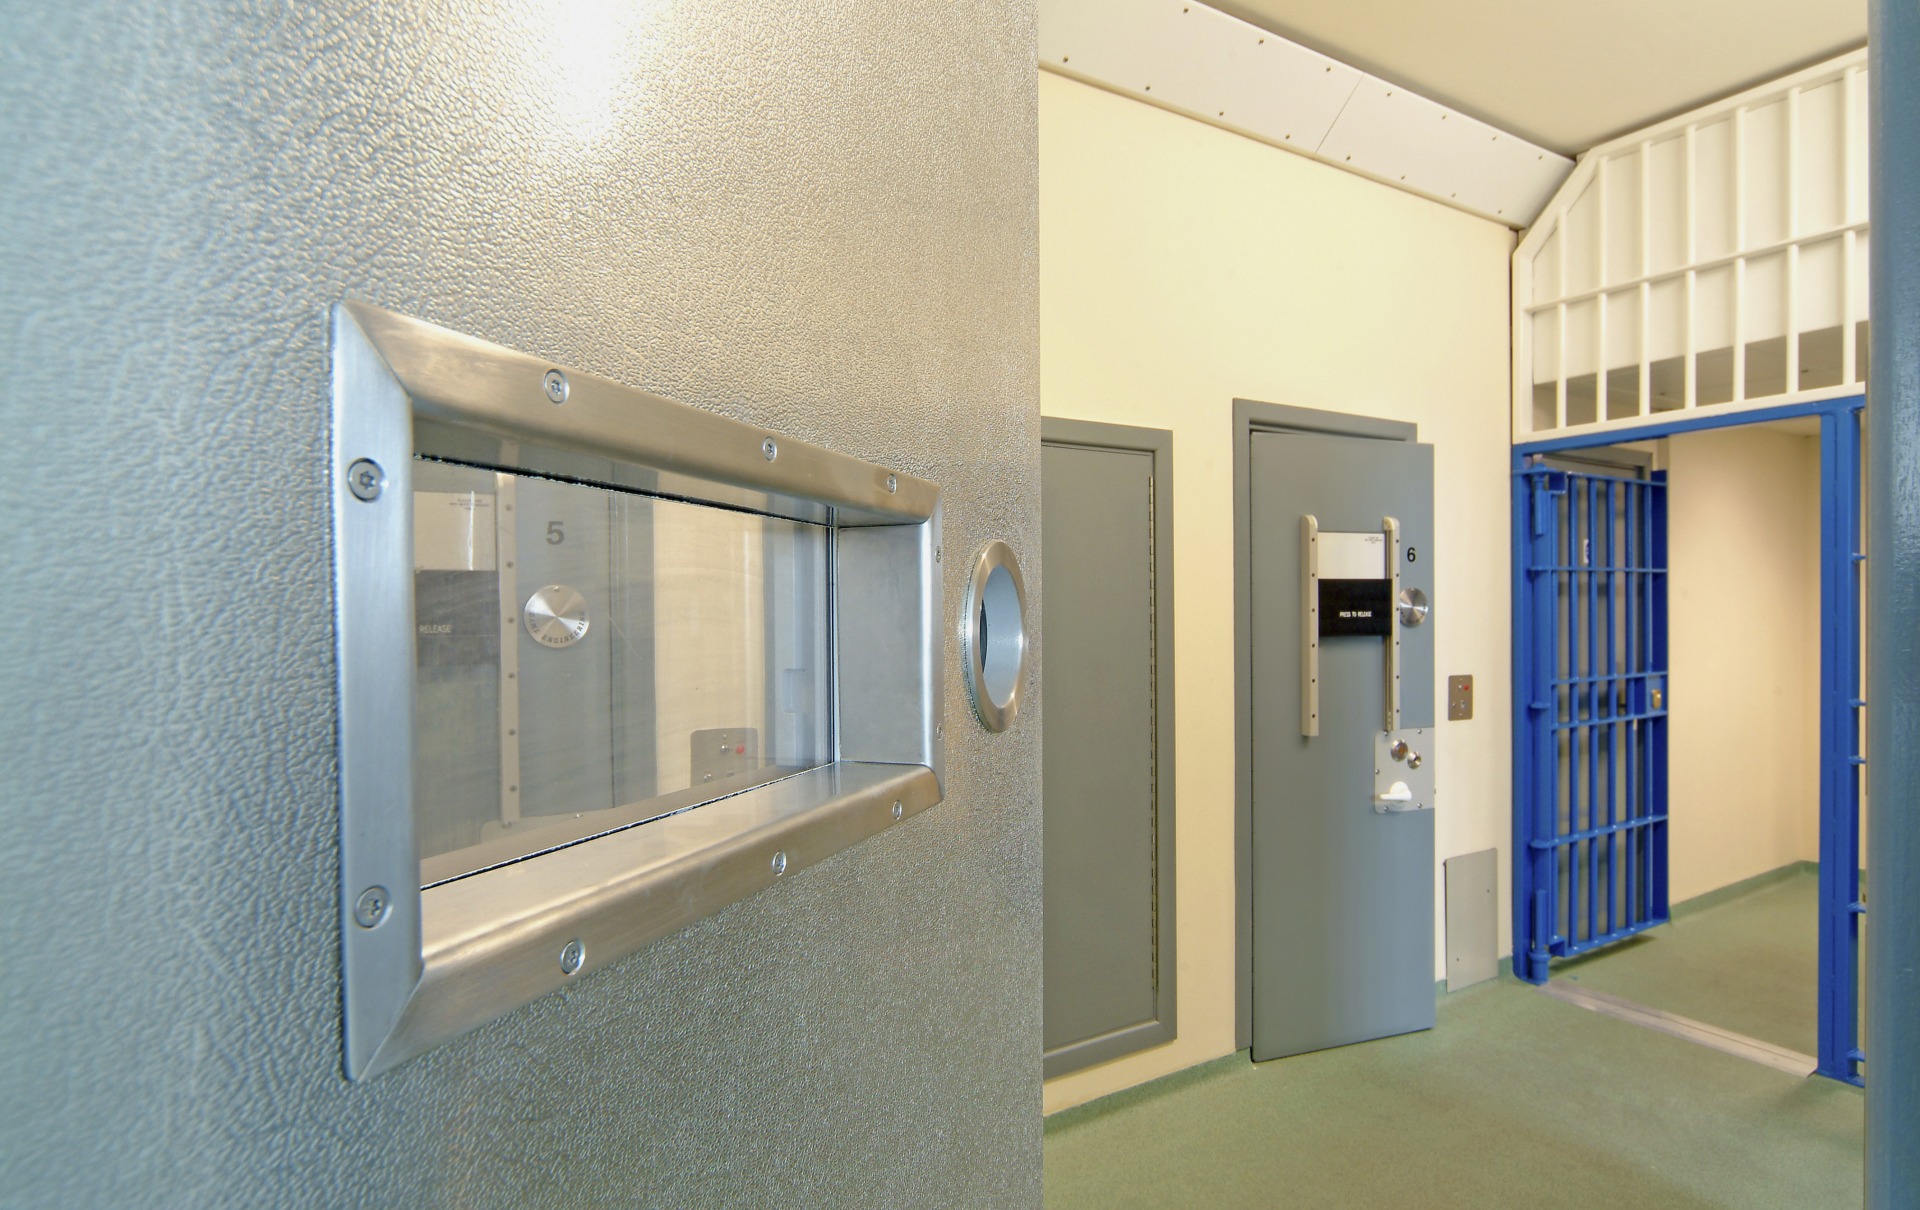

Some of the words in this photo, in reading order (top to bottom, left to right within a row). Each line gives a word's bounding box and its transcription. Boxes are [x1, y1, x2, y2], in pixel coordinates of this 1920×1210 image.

[546, 520, 564, 545] 5
[1406, 547, 1416, 562] 6
[419, 624, 452, 634] RELEASE
